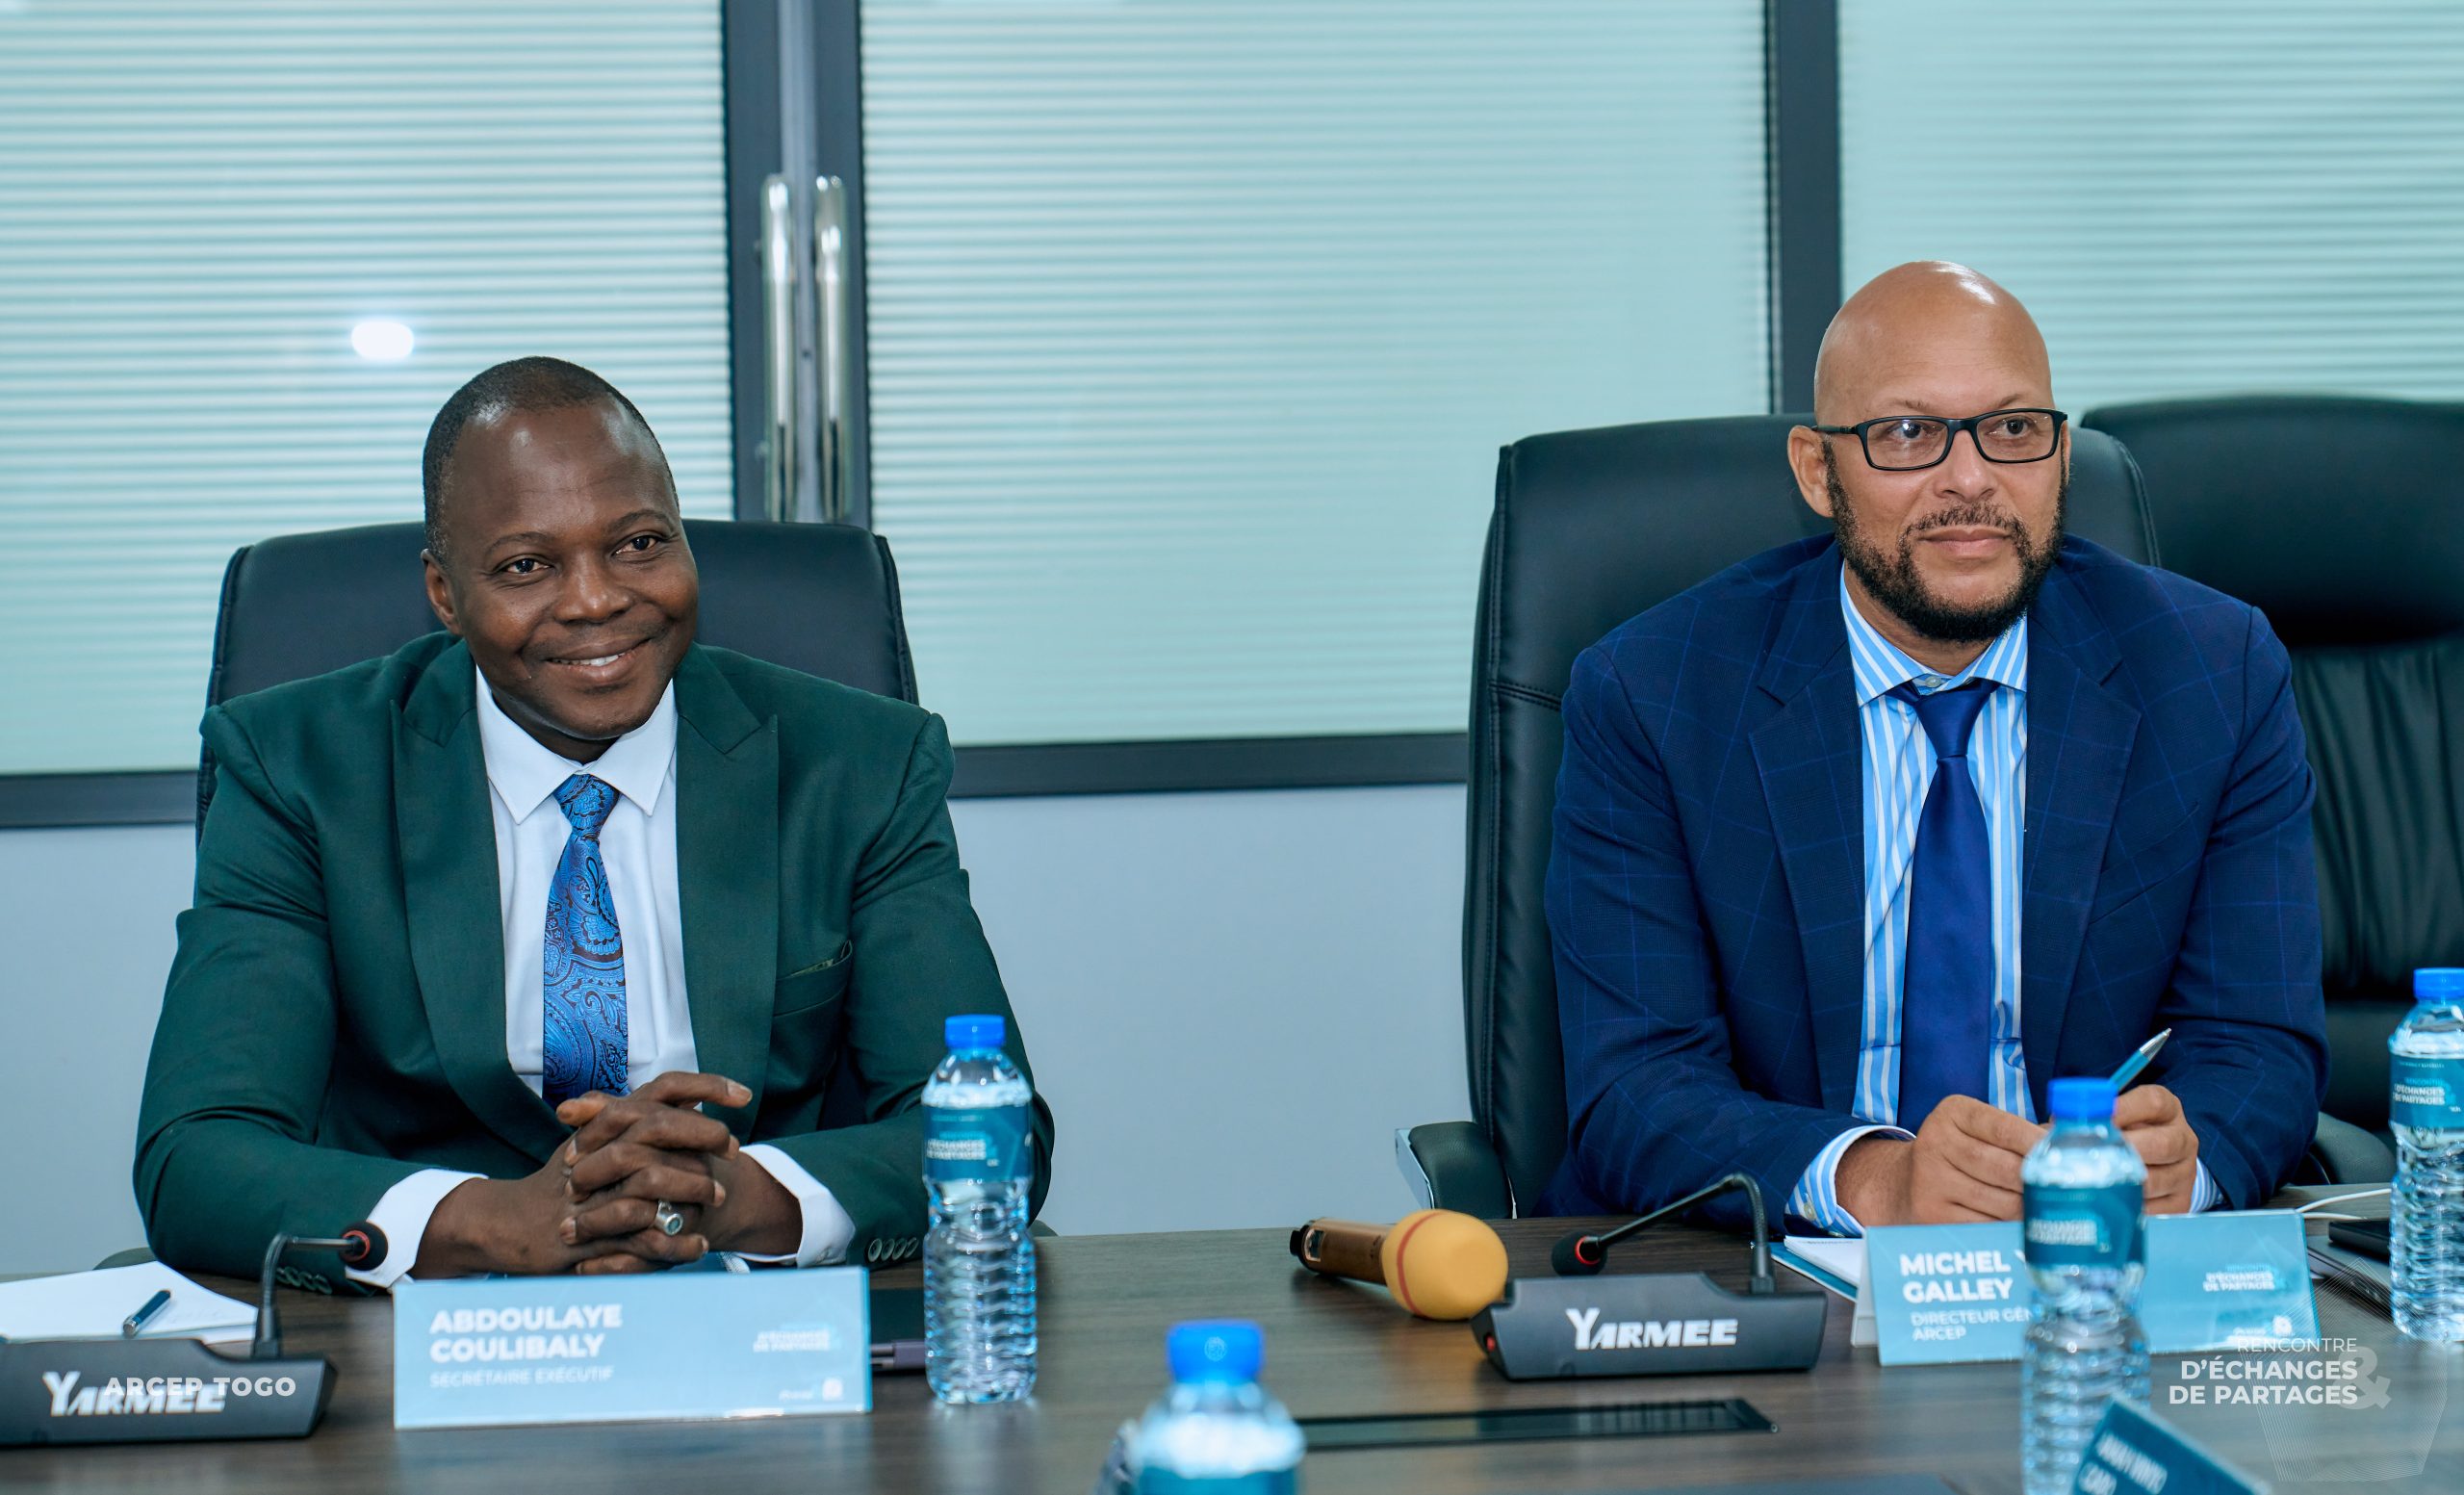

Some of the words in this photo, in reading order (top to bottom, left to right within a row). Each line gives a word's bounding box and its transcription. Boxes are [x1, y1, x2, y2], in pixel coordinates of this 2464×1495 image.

[1899, 1250, 2012, 1276] MICHEL
[1902, 1277, 2014, 1303] GALLEY
[429, 1303, 624, 1334] ABDOULAYE
[1565, 1306, 1739, 1351] YARMEE
[1910, 1309, 2001, 1327] DIRECTEUR
[1912, 1325, 1966, 1342] ARCEP
[429, 1333, 606, 1363] COULIBALY
